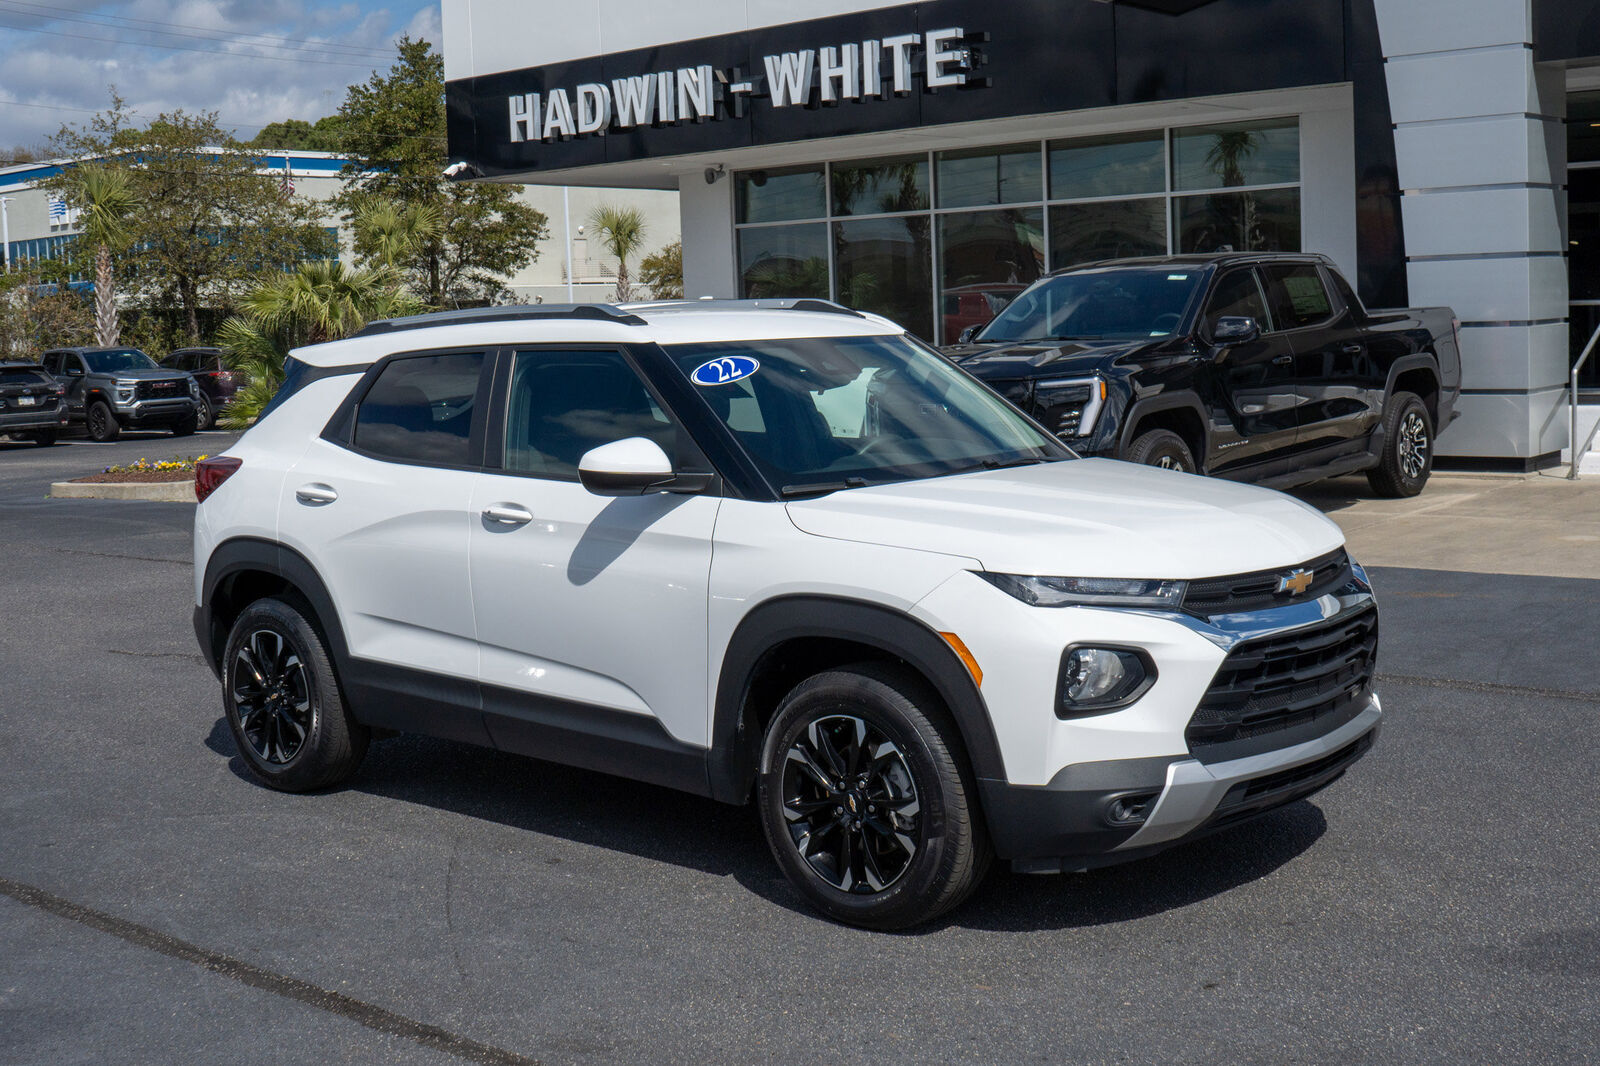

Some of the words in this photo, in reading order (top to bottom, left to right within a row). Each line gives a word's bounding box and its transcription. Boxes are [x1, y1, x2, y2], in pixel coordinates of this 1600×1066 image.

[509, 65, 714, 143] HADWIN
[763, 27, 966, 107] WHITE
[709, 358, 743, 382] 22
